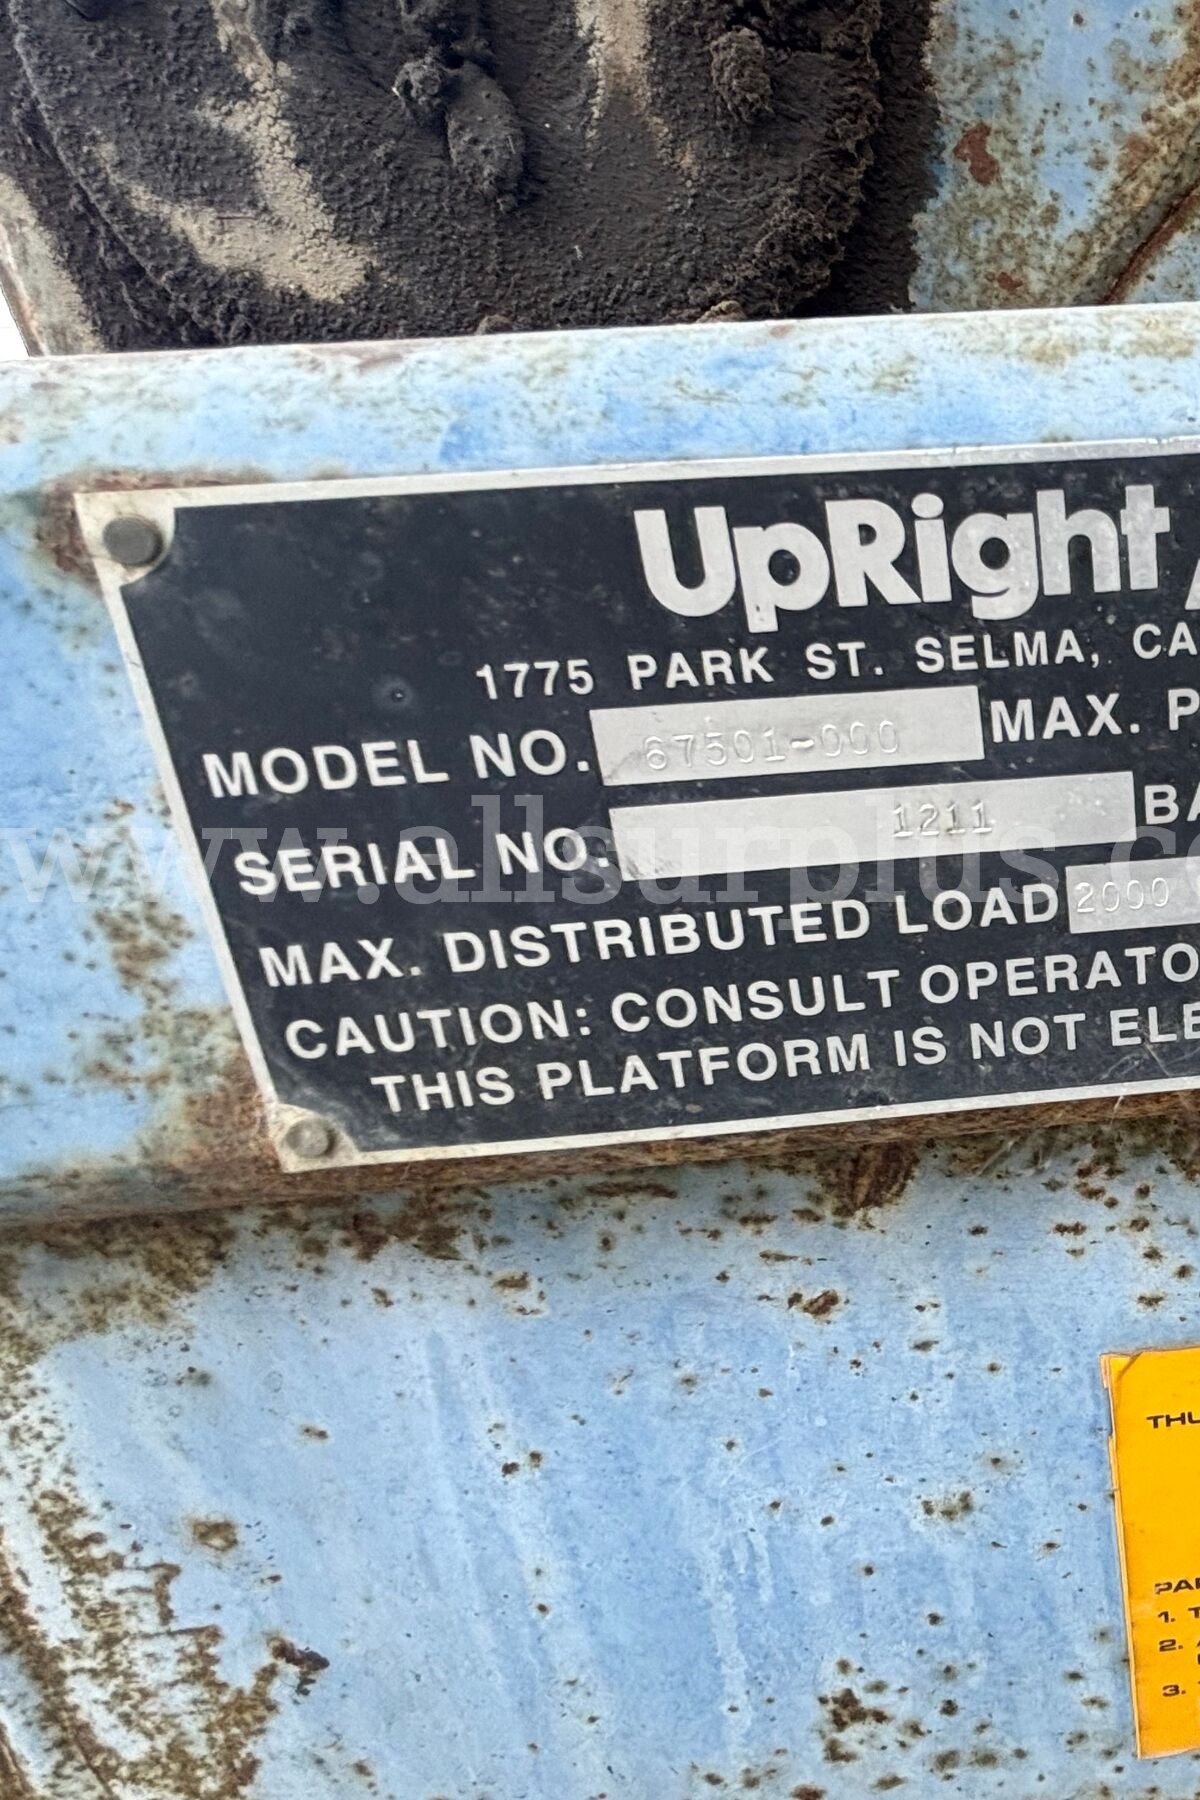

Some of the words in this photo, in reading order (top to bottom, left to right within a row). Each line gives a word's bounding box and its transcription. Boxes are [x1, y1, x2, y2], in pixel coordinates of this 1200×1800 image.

[476, 657, 594, 702] 1775
[628, 645, 773, 691] PARK
[806, 640, 884, 680] ST.
[916, 628, 1100, 674] SELMA,
[203, 738, 449, 799] MODEL
[471, 728, 590, 780] NO.
[643, 720, 901, 771] 67501-000
[991, 693, 1140, 743] MAX.
[234, 836, 476, 896] SERIAL
[495, 826, 610, 876] NO.
[892, 800, 993, 839] 1211
[259, 937, 421, 988] MAX.
[443, 898, 870, 974] DISTRIBUTED
[897, 883, 1059, 935] LOAD
[1075, 876, 1170, 914] 2000
[285, 999, 591, 1061] CAUTION:
[611, 968, 900, 1034] CONSULT
[371, 1066, 515, 1114] THIS
[537, 1032, 871, 1101] PLATFORM
[895, 1025, 947, 1067] IS
[970, 1012, 1087, 1060] NOT
[1157, 1610, 1177, 1624] 1.
[1158, 1638, 1184, 1652] 2.
[1162, 1684, 1187, 1697] 3.
